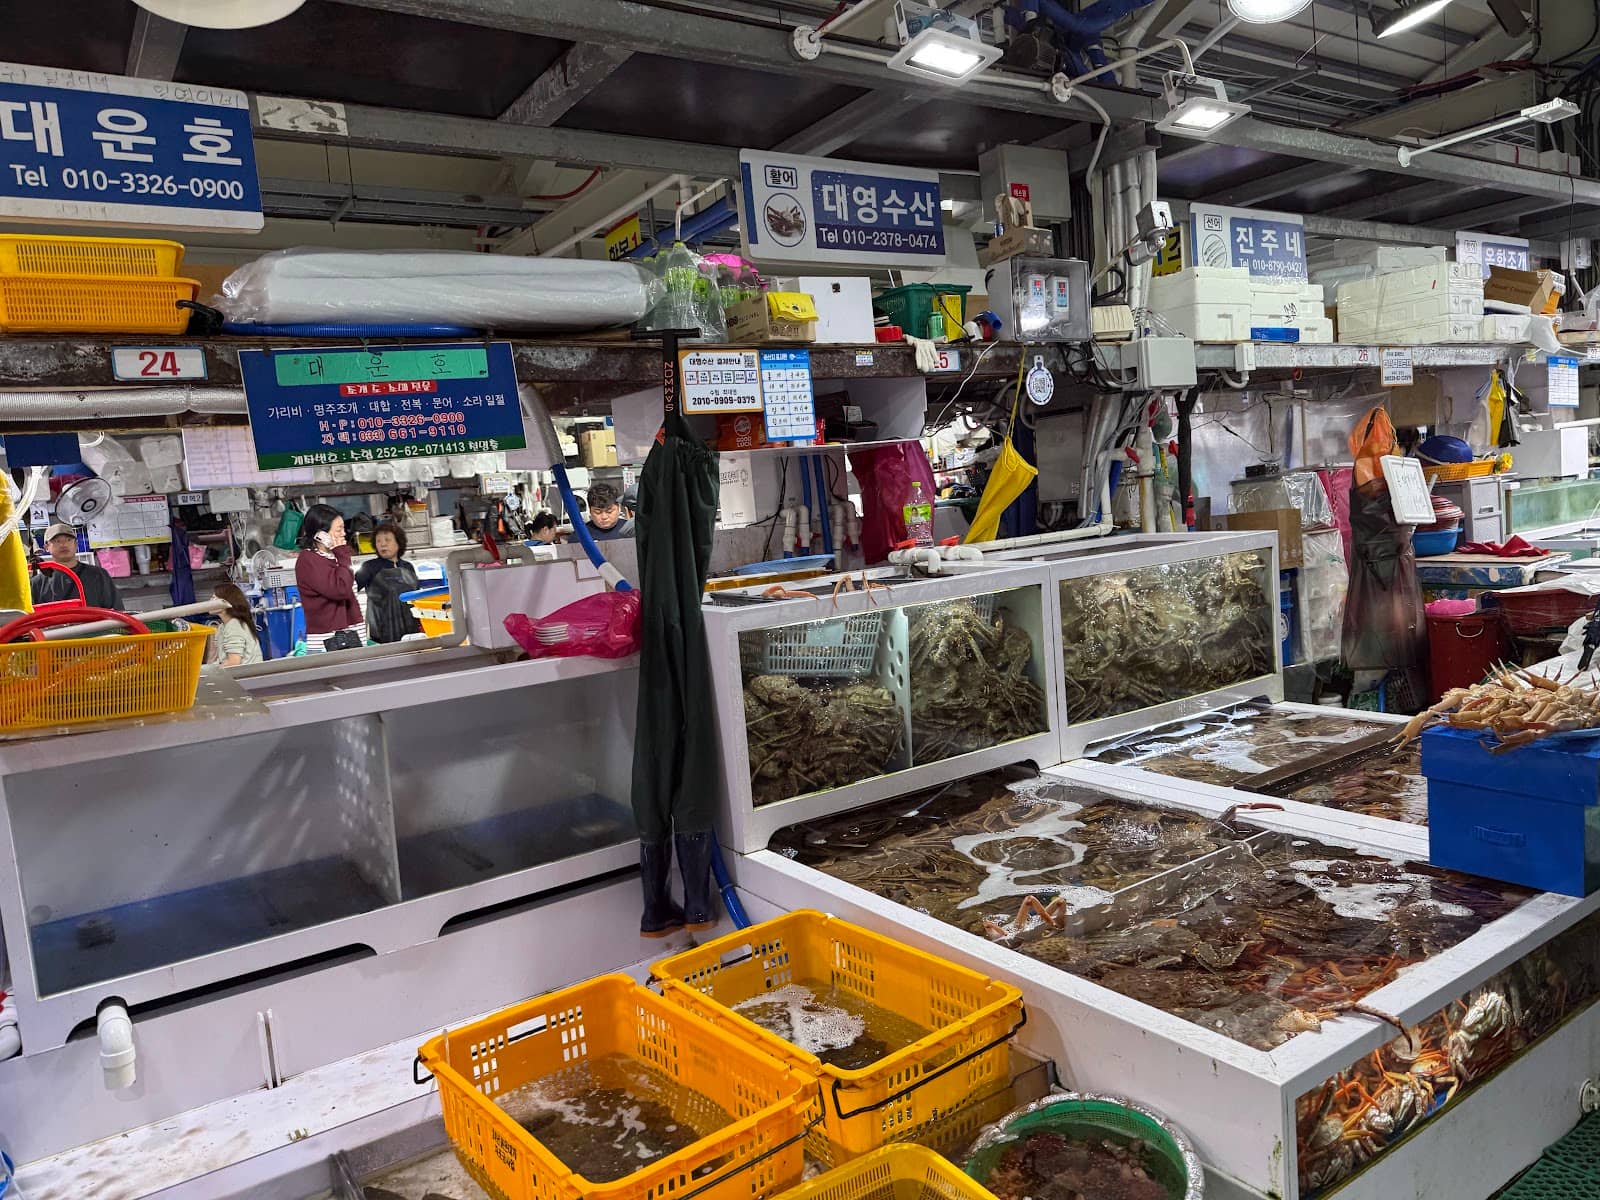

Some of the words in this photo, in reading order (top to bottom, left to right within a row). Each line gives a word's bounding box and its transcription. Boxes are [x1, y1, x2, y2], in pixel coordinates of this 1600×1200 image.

[9, 164, 49, 187] Tel
[63, 168, 244, 200] 010-3326-0900
[770, 169, 795, 186] 활어
[821, 183, 935, 227] 대영수산
[819, 227, 839, 244] Tel
[843, 229, 938, 249] 010-2378-0474
[1236, 226, 1301, 257] 진주네
[138, 351, 181, 376] 24
[933, 351, 949, 369] 5
[268, 405, 303, 419] 가리비
[314, 401, 358, 416] 명주조개
[369, 400, 391, 412] 대합
[401, 397, 422, 411] 전복
[432, 396, 453, 409] 문어
[463, 395, 482, 407] 소라
[692, 395, 756, 406] 2010-0909-0379
[358, 411, 465, 430] 010-3326-0900
[388, 424, 467, 440] 661-9110
[376, 441, 466, 459] 252-62-071413
